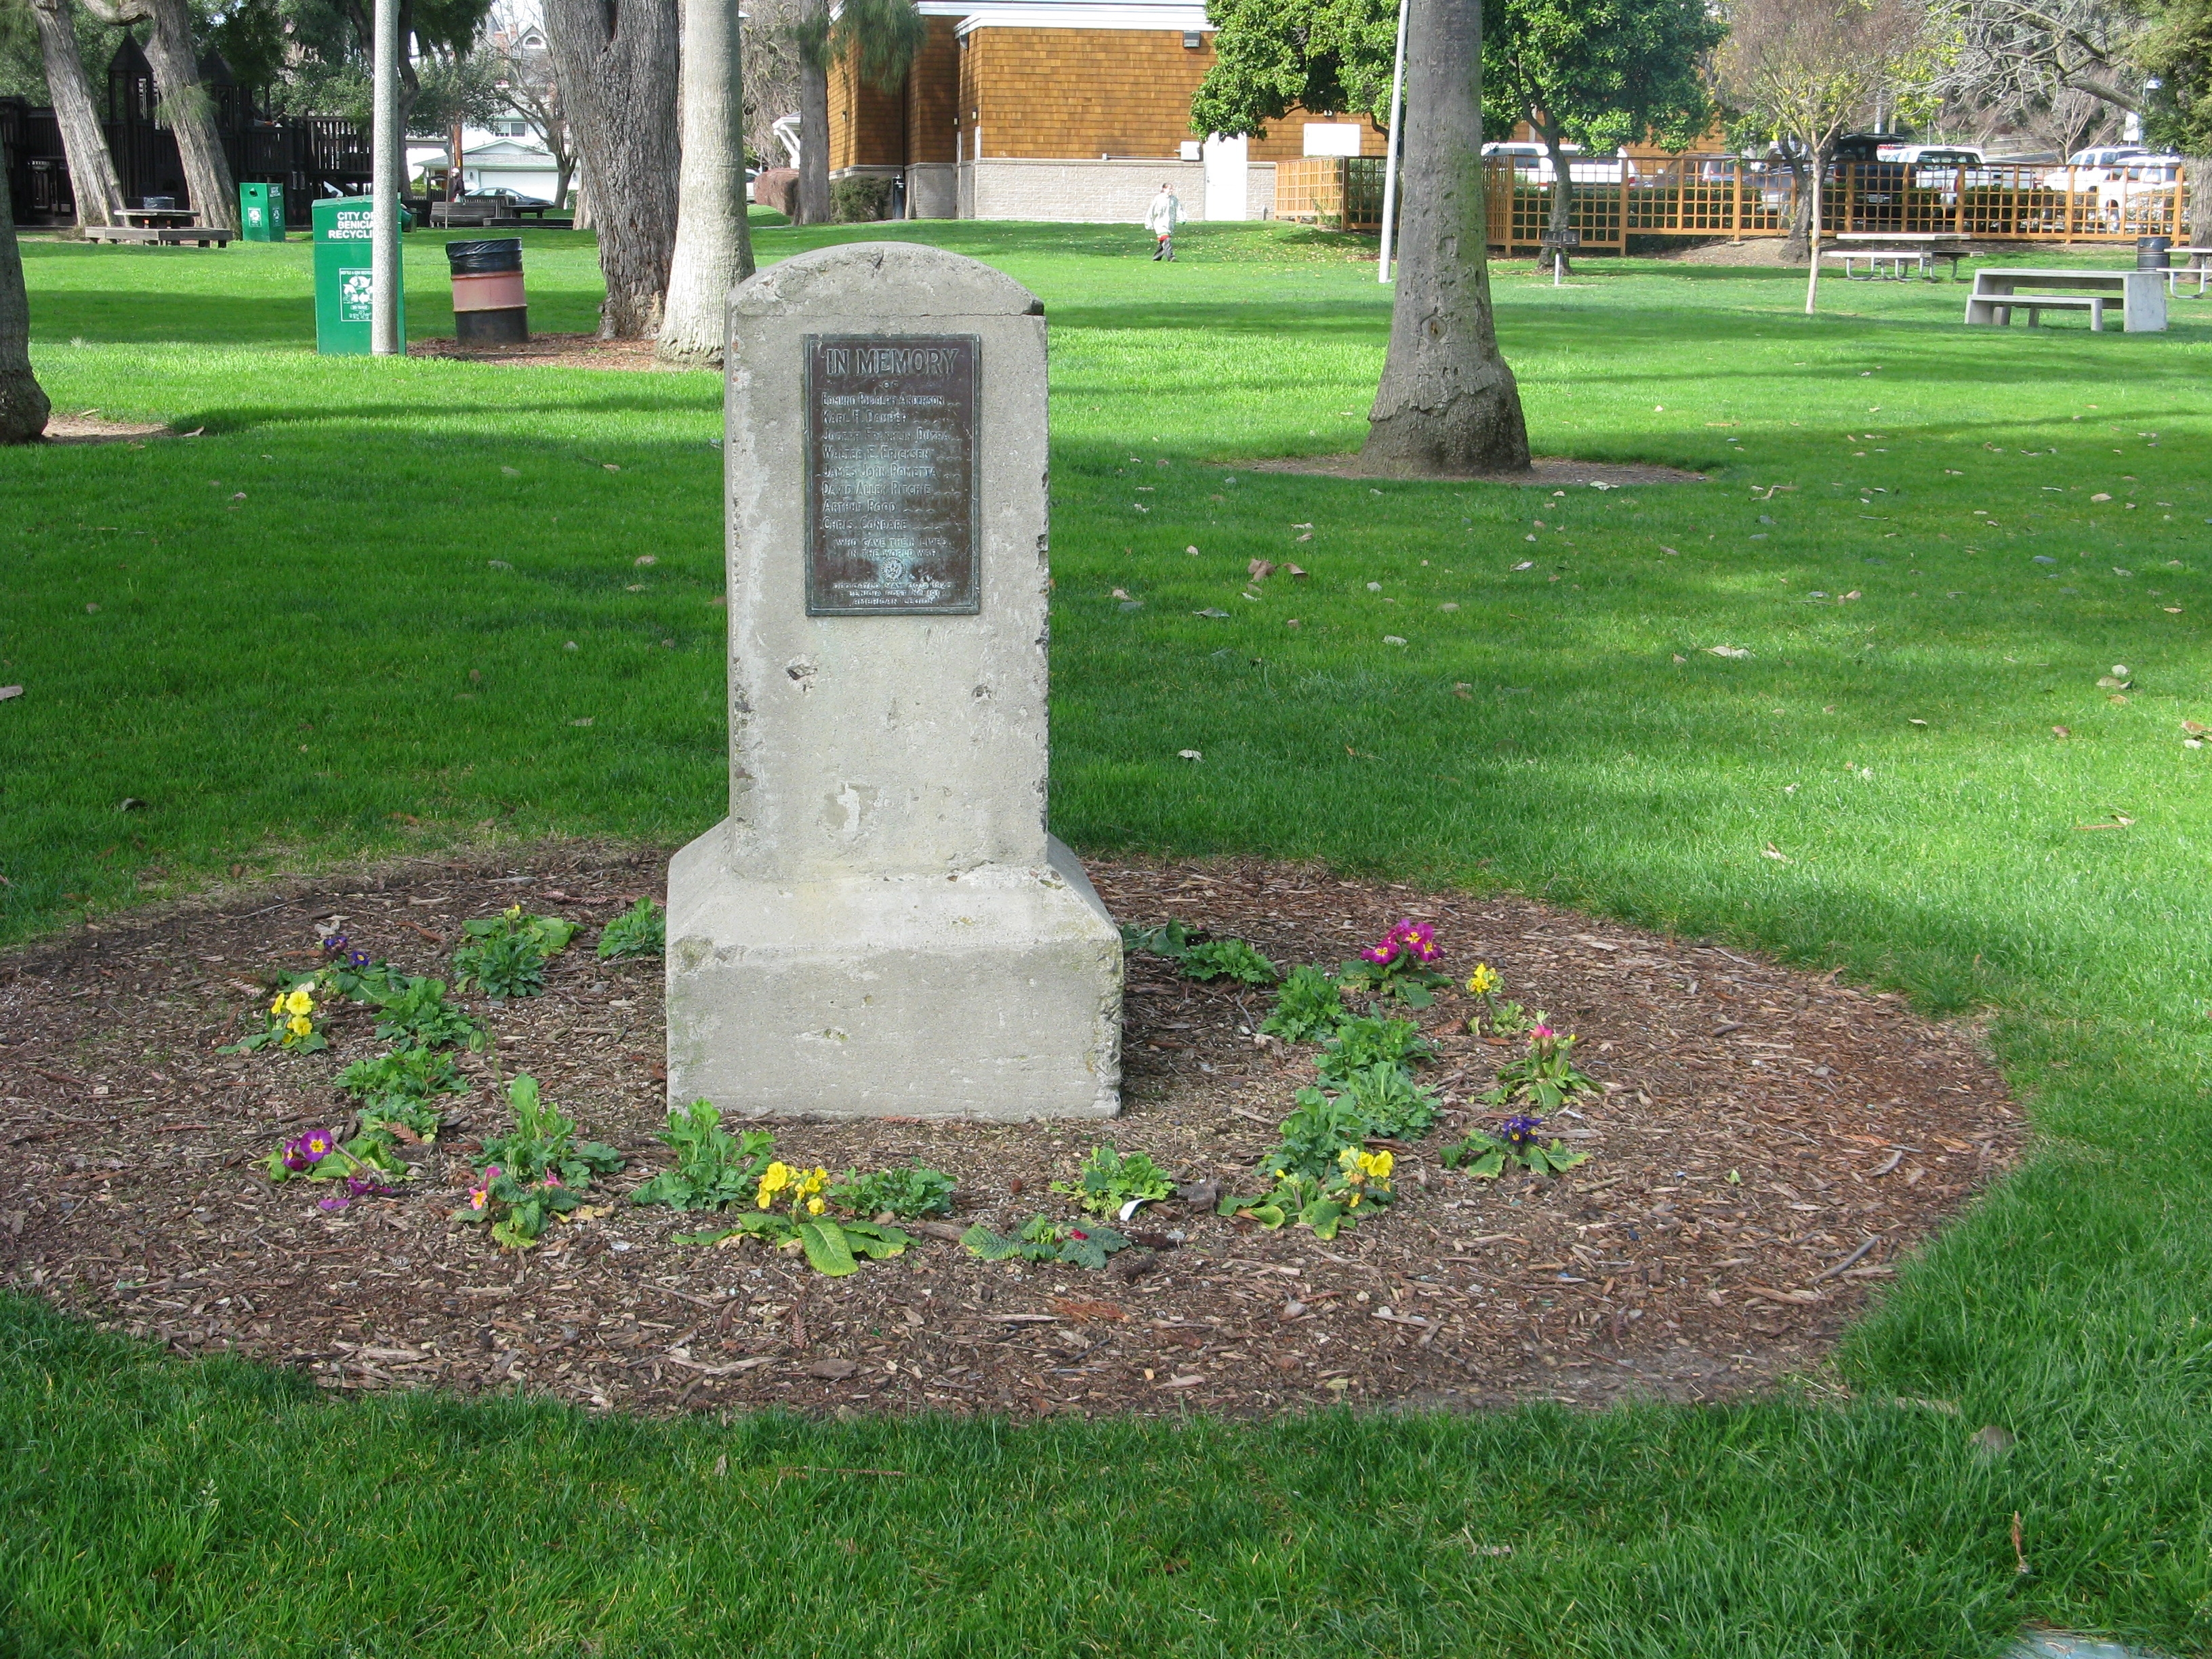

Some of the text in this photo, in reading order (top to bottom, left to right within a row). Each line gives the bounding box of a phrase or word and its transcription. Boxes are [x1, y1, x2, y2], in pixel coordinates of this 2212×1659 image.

[337, 211, 361, 220] CITY
[826, 348, 959, 374] IN MEMORY
[859, 392, 897, 406] RUDOLPH
[899, 391, 945, 406] ANDERSON
[822, 409, 850, 424] KARL
[822, 427, 861, 441] JOSEPH
[865, 426, 912, 441] FRANKLIN
[822, 445, 864, 459] WALTER
[880, 443, 931, 459] ERICKSEN
[822, 462, 857, 478] JAMES
[861, 462, 887, 477] JOHN
[821, 480, 932, 495] DAVID ALLEN RITCHIE
[822, 498, 897, 512] ARTHUR ROOD
[822, 516, 855, 530] CHRIS
[835, 537, 947, 547] WHO GAVE THEIR LIVES
[848, 549, 937, 558] IN THE WORLD WAR
[853, 597, 935, 605] AMERICAN LEGION
